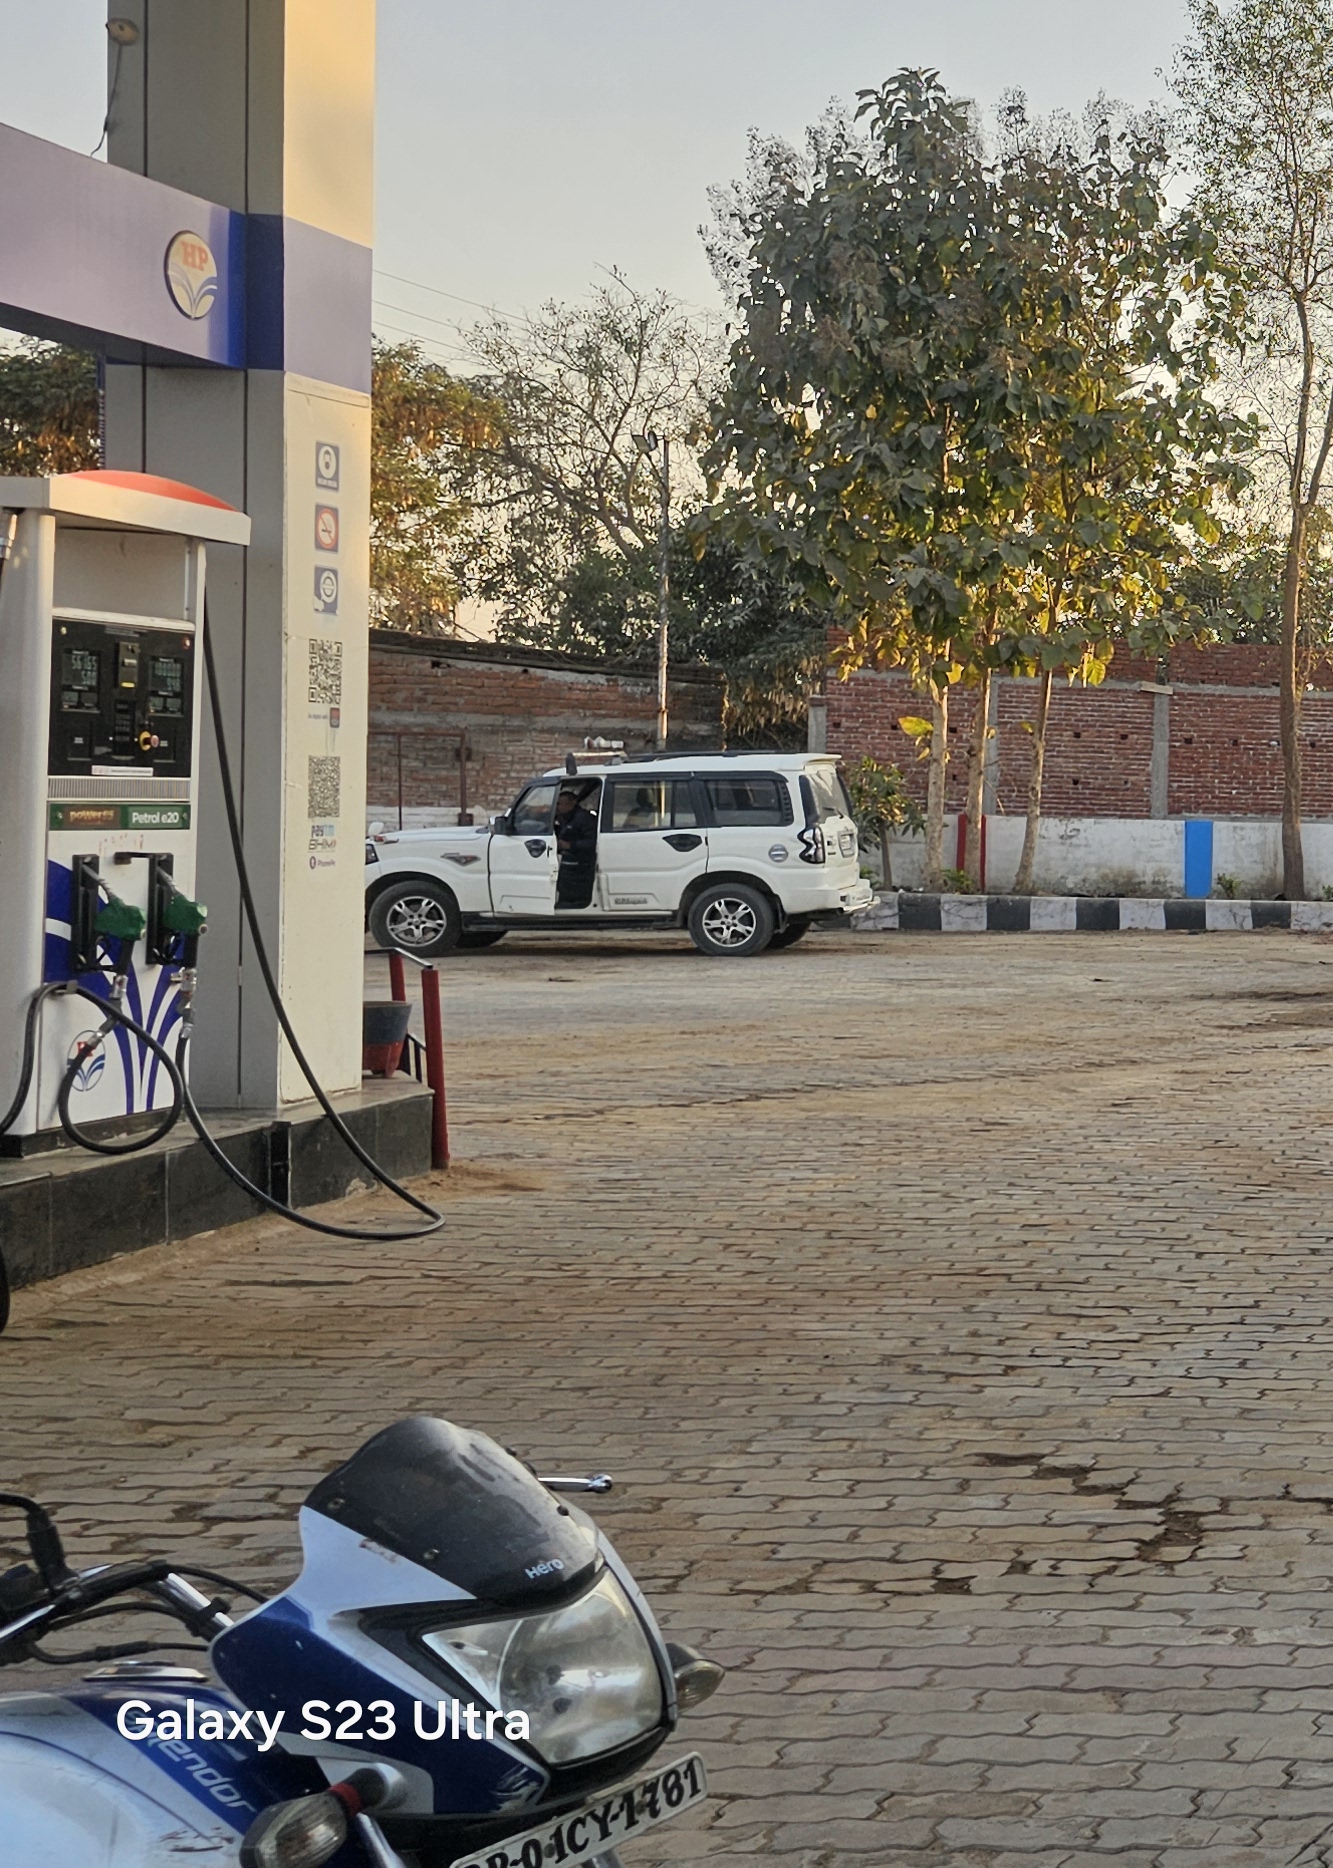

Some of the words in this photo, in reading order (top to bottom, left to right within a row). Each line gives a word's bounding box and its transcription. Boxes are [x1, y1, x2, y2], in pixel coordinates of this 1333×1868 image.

[181, 241, 208, 271] HP
[132, 811, 160, 824] Petrol
[161, 811, 180, 824] e20
[524, 1558, 565, 1579] Hero
[464, 1759, 703, 1868] -01CY-1781
